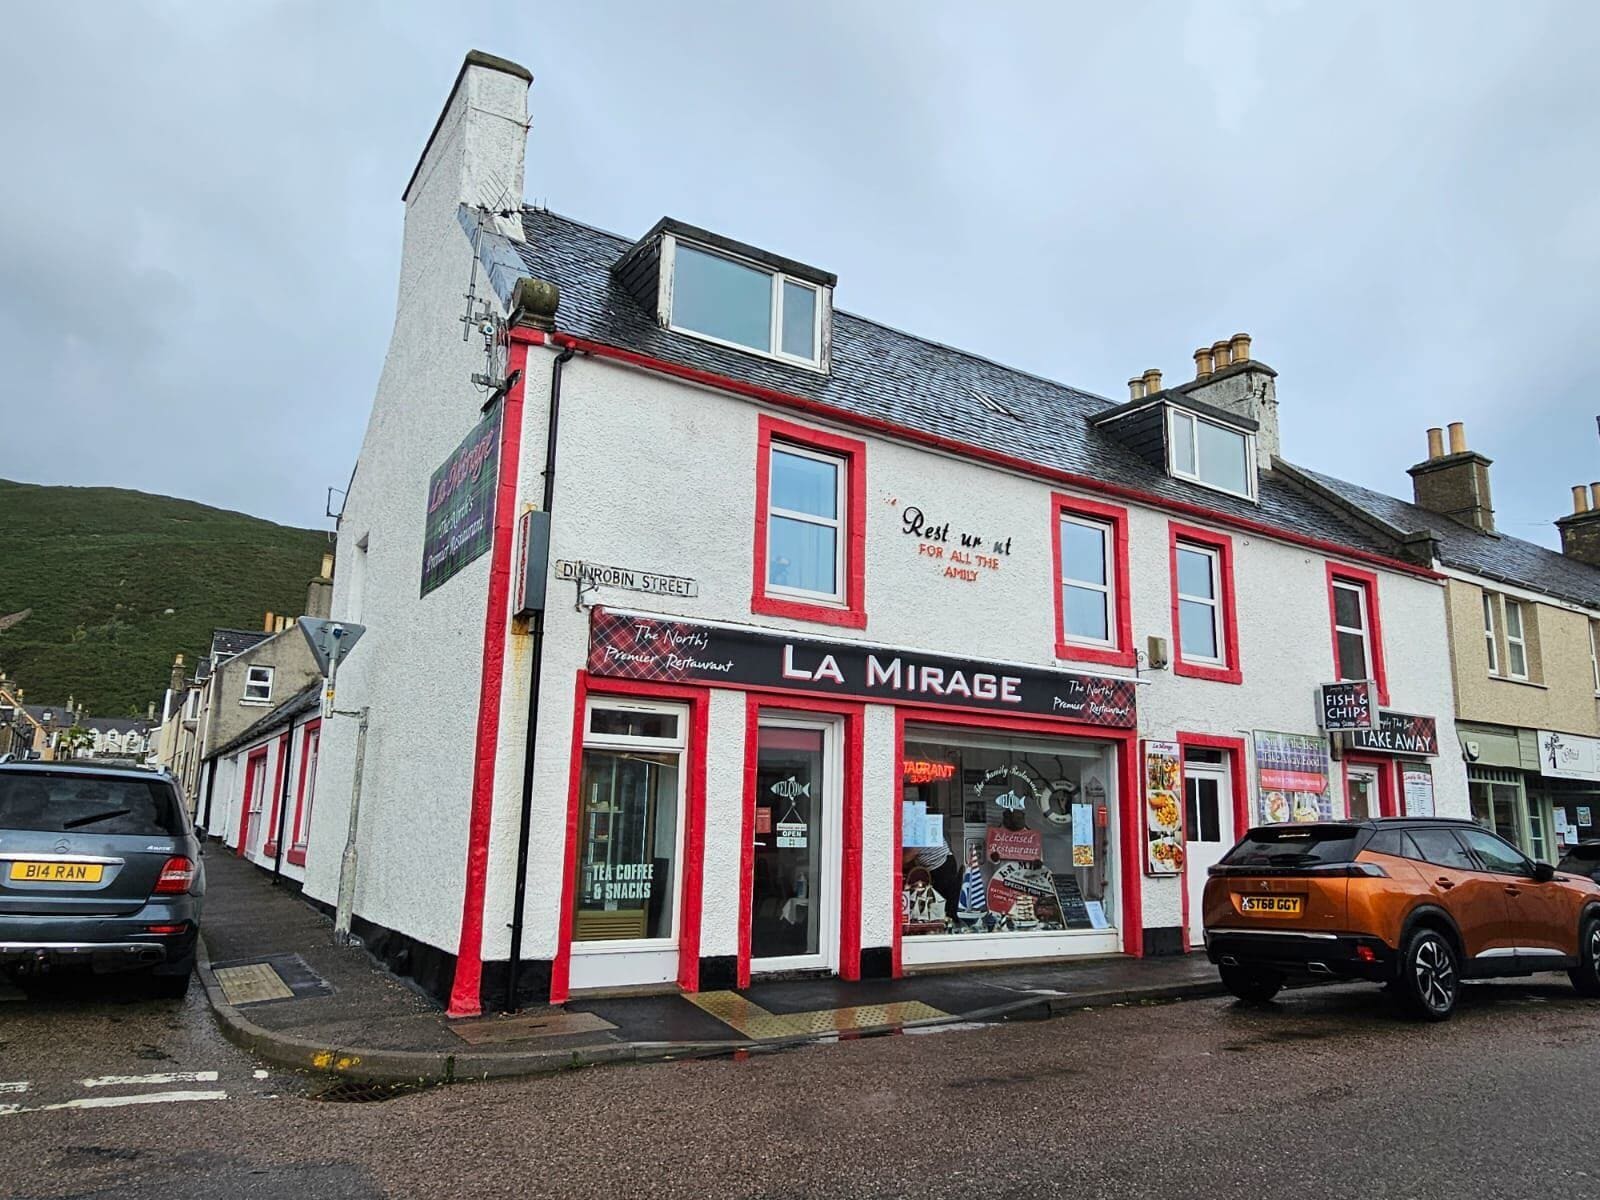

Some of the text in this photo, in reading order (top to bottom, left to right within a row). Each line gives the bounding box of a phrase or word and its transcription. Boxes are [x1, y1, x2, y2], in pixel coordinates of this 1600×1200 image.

[918, 543, 999, 571] FOR ALL THE
[562, 563, 691, 595] DUNROBIN STREET
[943, 566, 979, 582] AMILY
[634, 624, 709, 650] The North's
[603, 644, 734, 673] Premier Restaurant
[782, 644, 1023, 703] LA MIRAGE
[1069, 680, 1114, 699] The North's
[1053, 696, 1130, 716] Premier Restaurant
[1326, 693, 1369, 706] FISH &
[1327, 706, 1367, 718] CHIPS
[1362, 730, 1431, 752] TAKE AWAY
[994, 831, 1034, 844] Licensed
[989, 843, 1039, 855] Restaurant
[26, 865, 86, 878] B14 RAN
[592, 864, 654, 880] TEA COFFEE
[594, 882, 651, 899] & SNACKS
[1248, 897, 1298, 911] ST68 GGY
